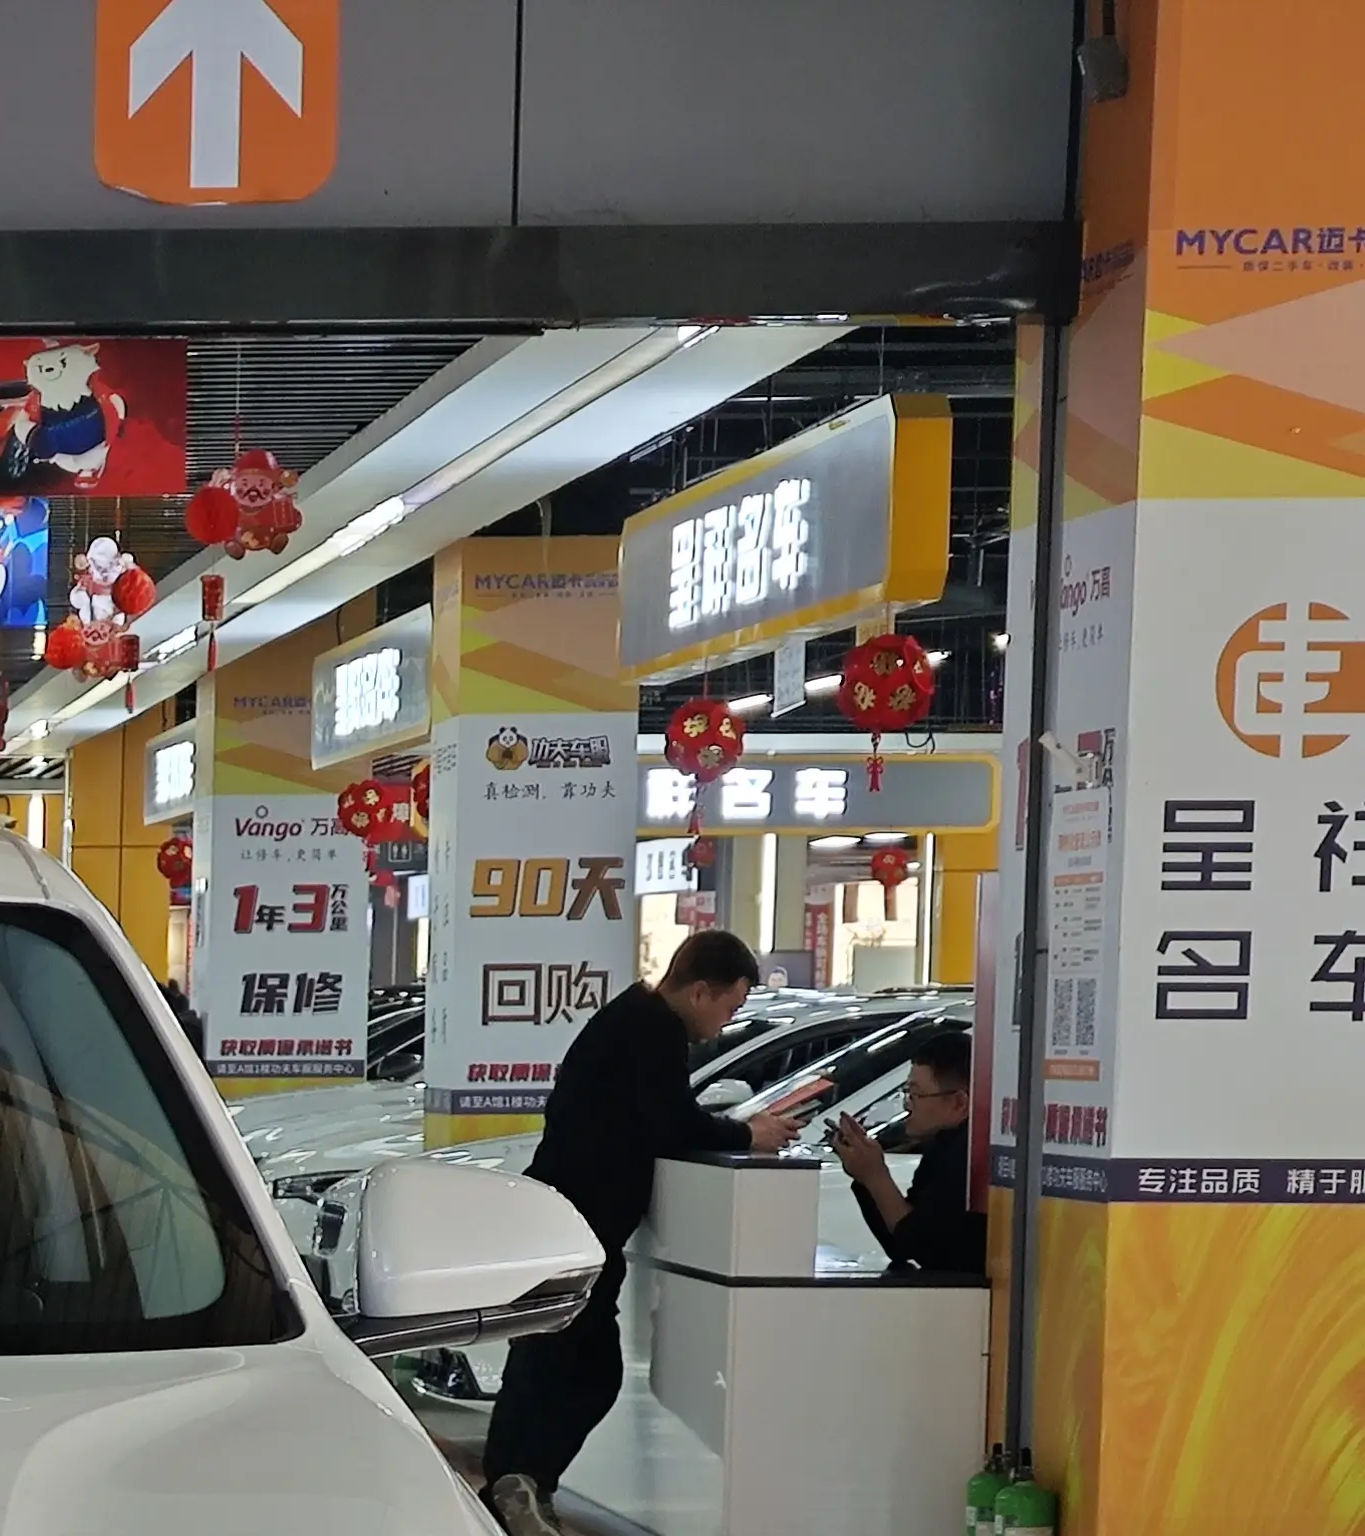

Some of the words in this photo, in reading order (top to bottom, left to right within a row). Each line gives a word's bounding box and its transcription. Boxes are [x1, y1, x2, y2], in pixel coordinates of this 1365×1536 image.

[235, 817, 303, 842] Vango
[469, 857, 626, 920] 90天
[240, 972, 343, 1015] 保修
[481, 961, 614, 1026] 回购
[467, 1064, 561, 1083] 获取质保
[1138, 1167, 1261, 1194] 专注品质
